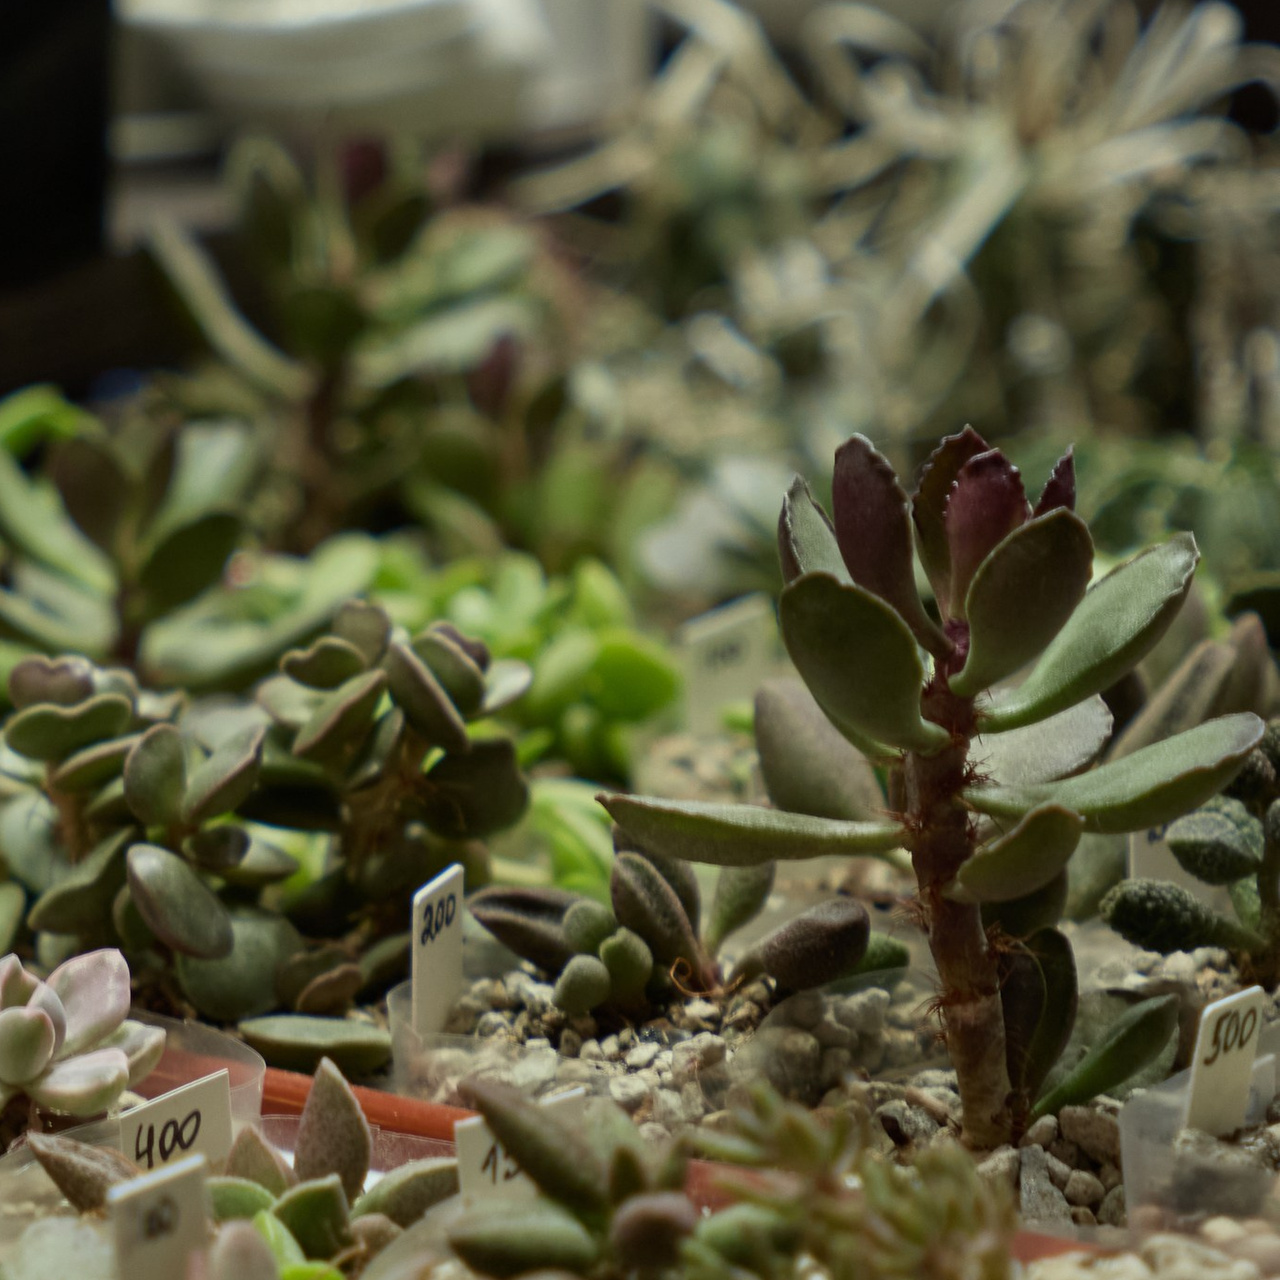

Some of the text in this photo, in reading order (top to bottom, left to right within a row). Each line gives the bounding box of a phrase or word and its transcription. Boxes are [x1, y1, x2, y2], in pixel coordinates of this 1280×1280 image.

[421, 893, 456, 946] 200
[1204, 1006, 1257, 1065] 500
[135, 1109, 201, 1169] 400
